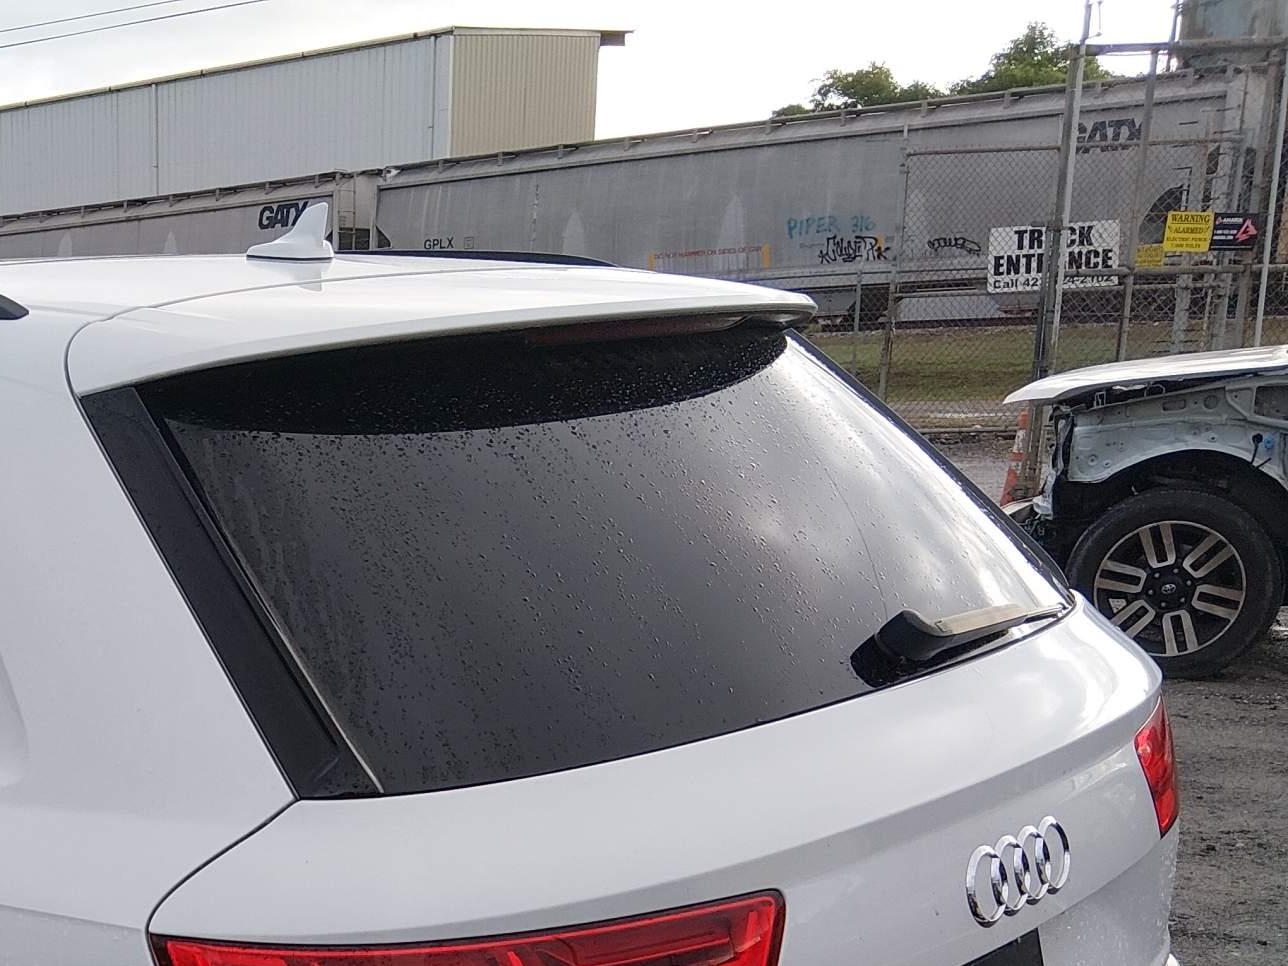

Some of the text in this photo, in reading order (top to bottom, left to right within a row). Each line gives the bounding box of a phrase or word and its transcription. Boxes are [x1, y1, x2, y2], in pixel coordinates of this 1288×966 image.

[1171, 213, 1210, 223] WARNING
[787, 216, 840, 239] PIPER
[1173, 226, 1204, 234] ALARMED
[424, 237, 454, 250] GPLX
[1014, 225, 1093, 251] TRCK
[993, 249, 1113, 276] ENTNCE
[993, 279, 1018, 289] Call
